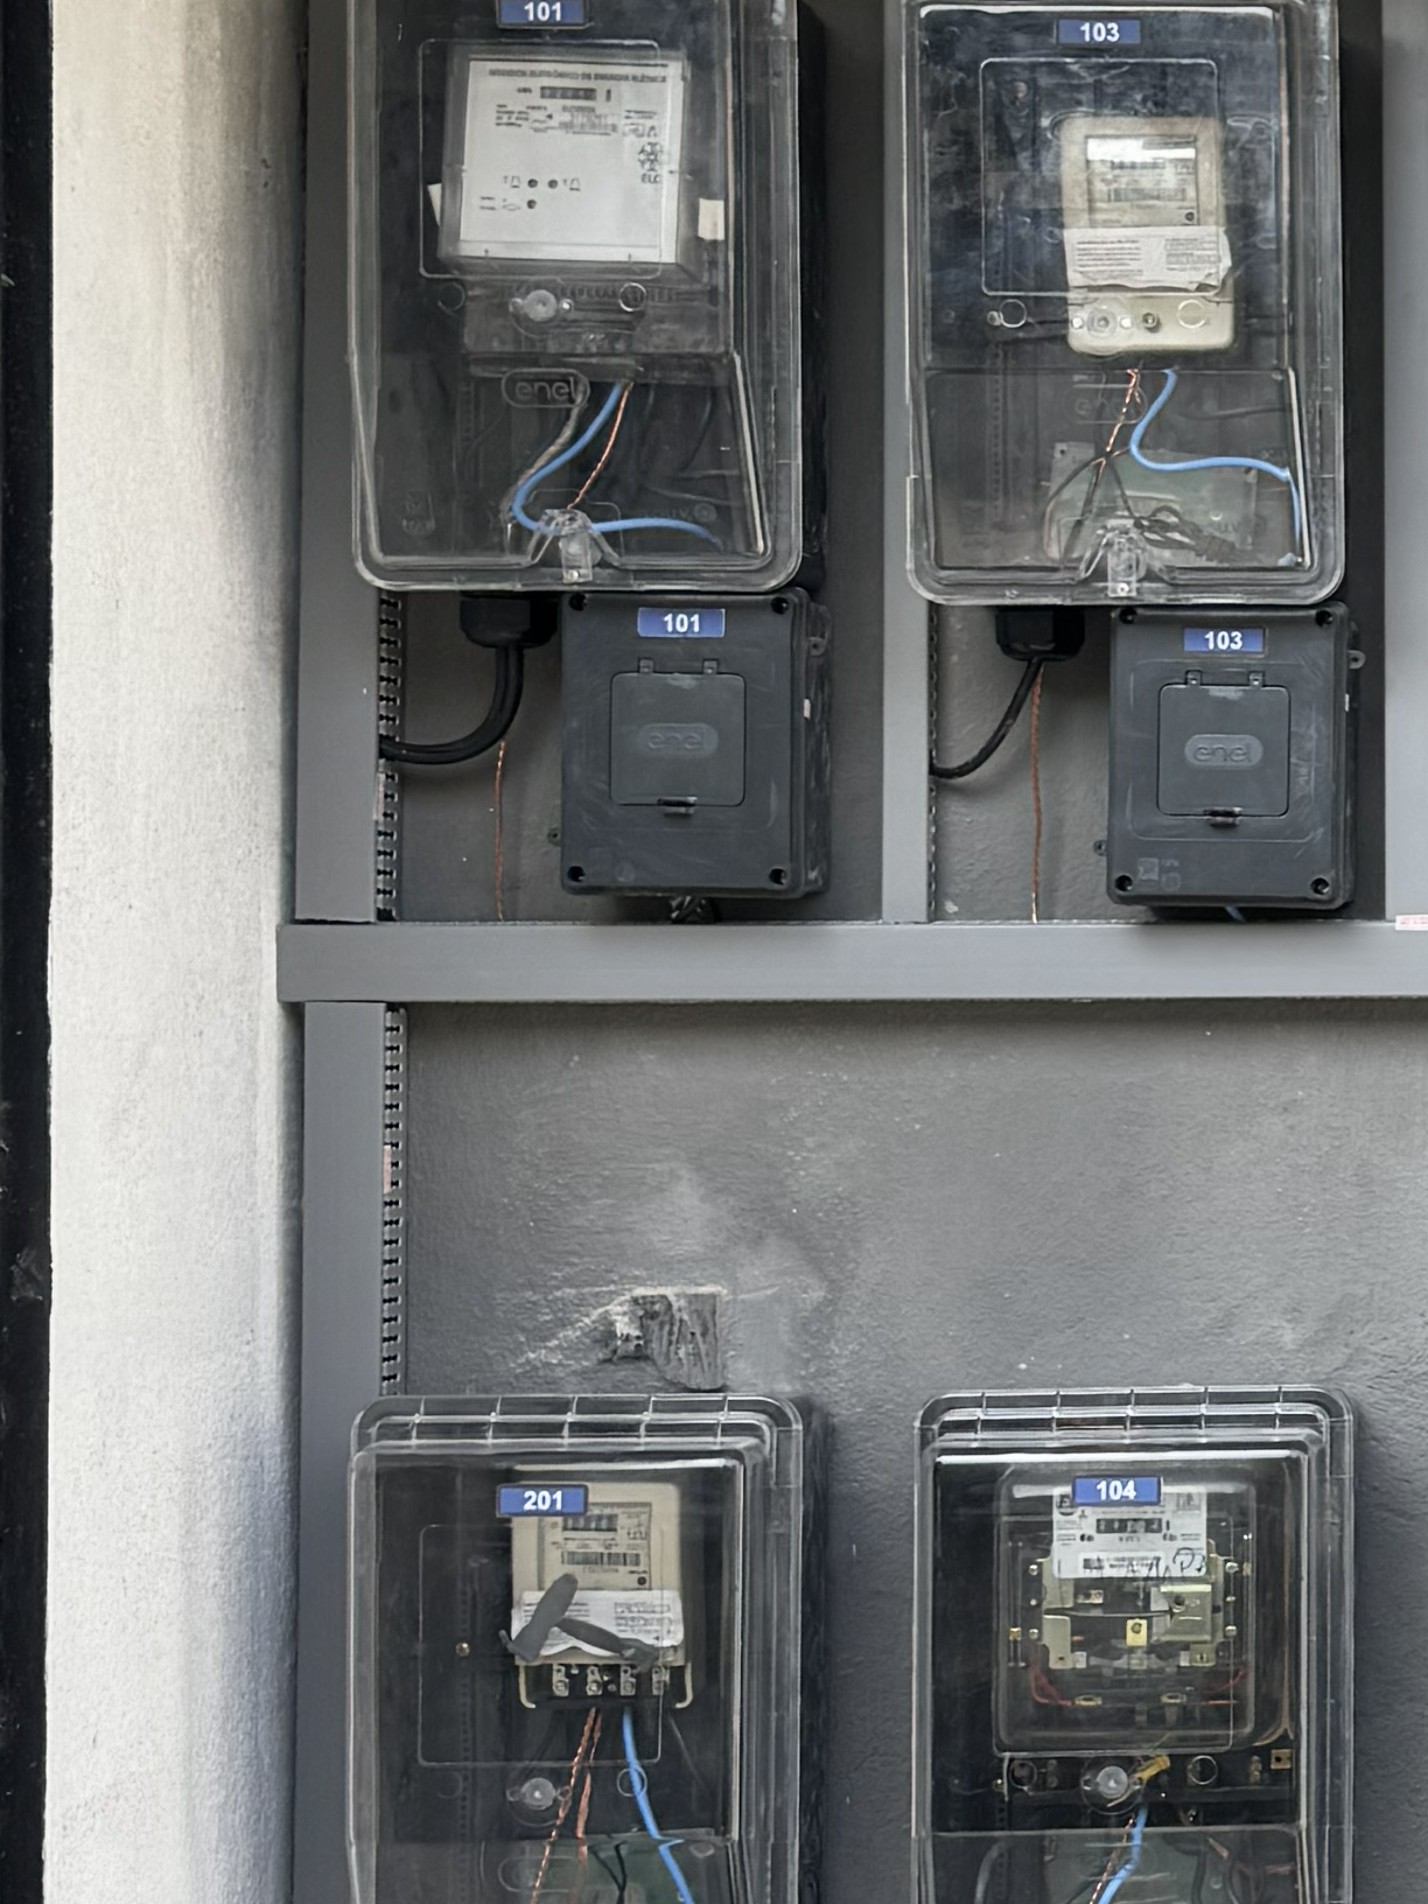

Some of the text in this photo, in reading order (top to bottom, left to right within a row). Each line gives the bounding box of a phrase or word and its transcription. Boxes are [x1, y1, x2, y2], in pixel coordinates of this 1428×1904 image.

[524, 1, 561, 22] 101
[1080, 22, 1120, 42] 103
[514, 375, 577, 402] enel
[663, 613, 700, 633] 101
[1204, 630, 1243, 651] 103
[1194, 742, 1253, 763] enel
[523, 1490, 562, 1511] 201
[1096, 1479, 1137, 1501] 104
